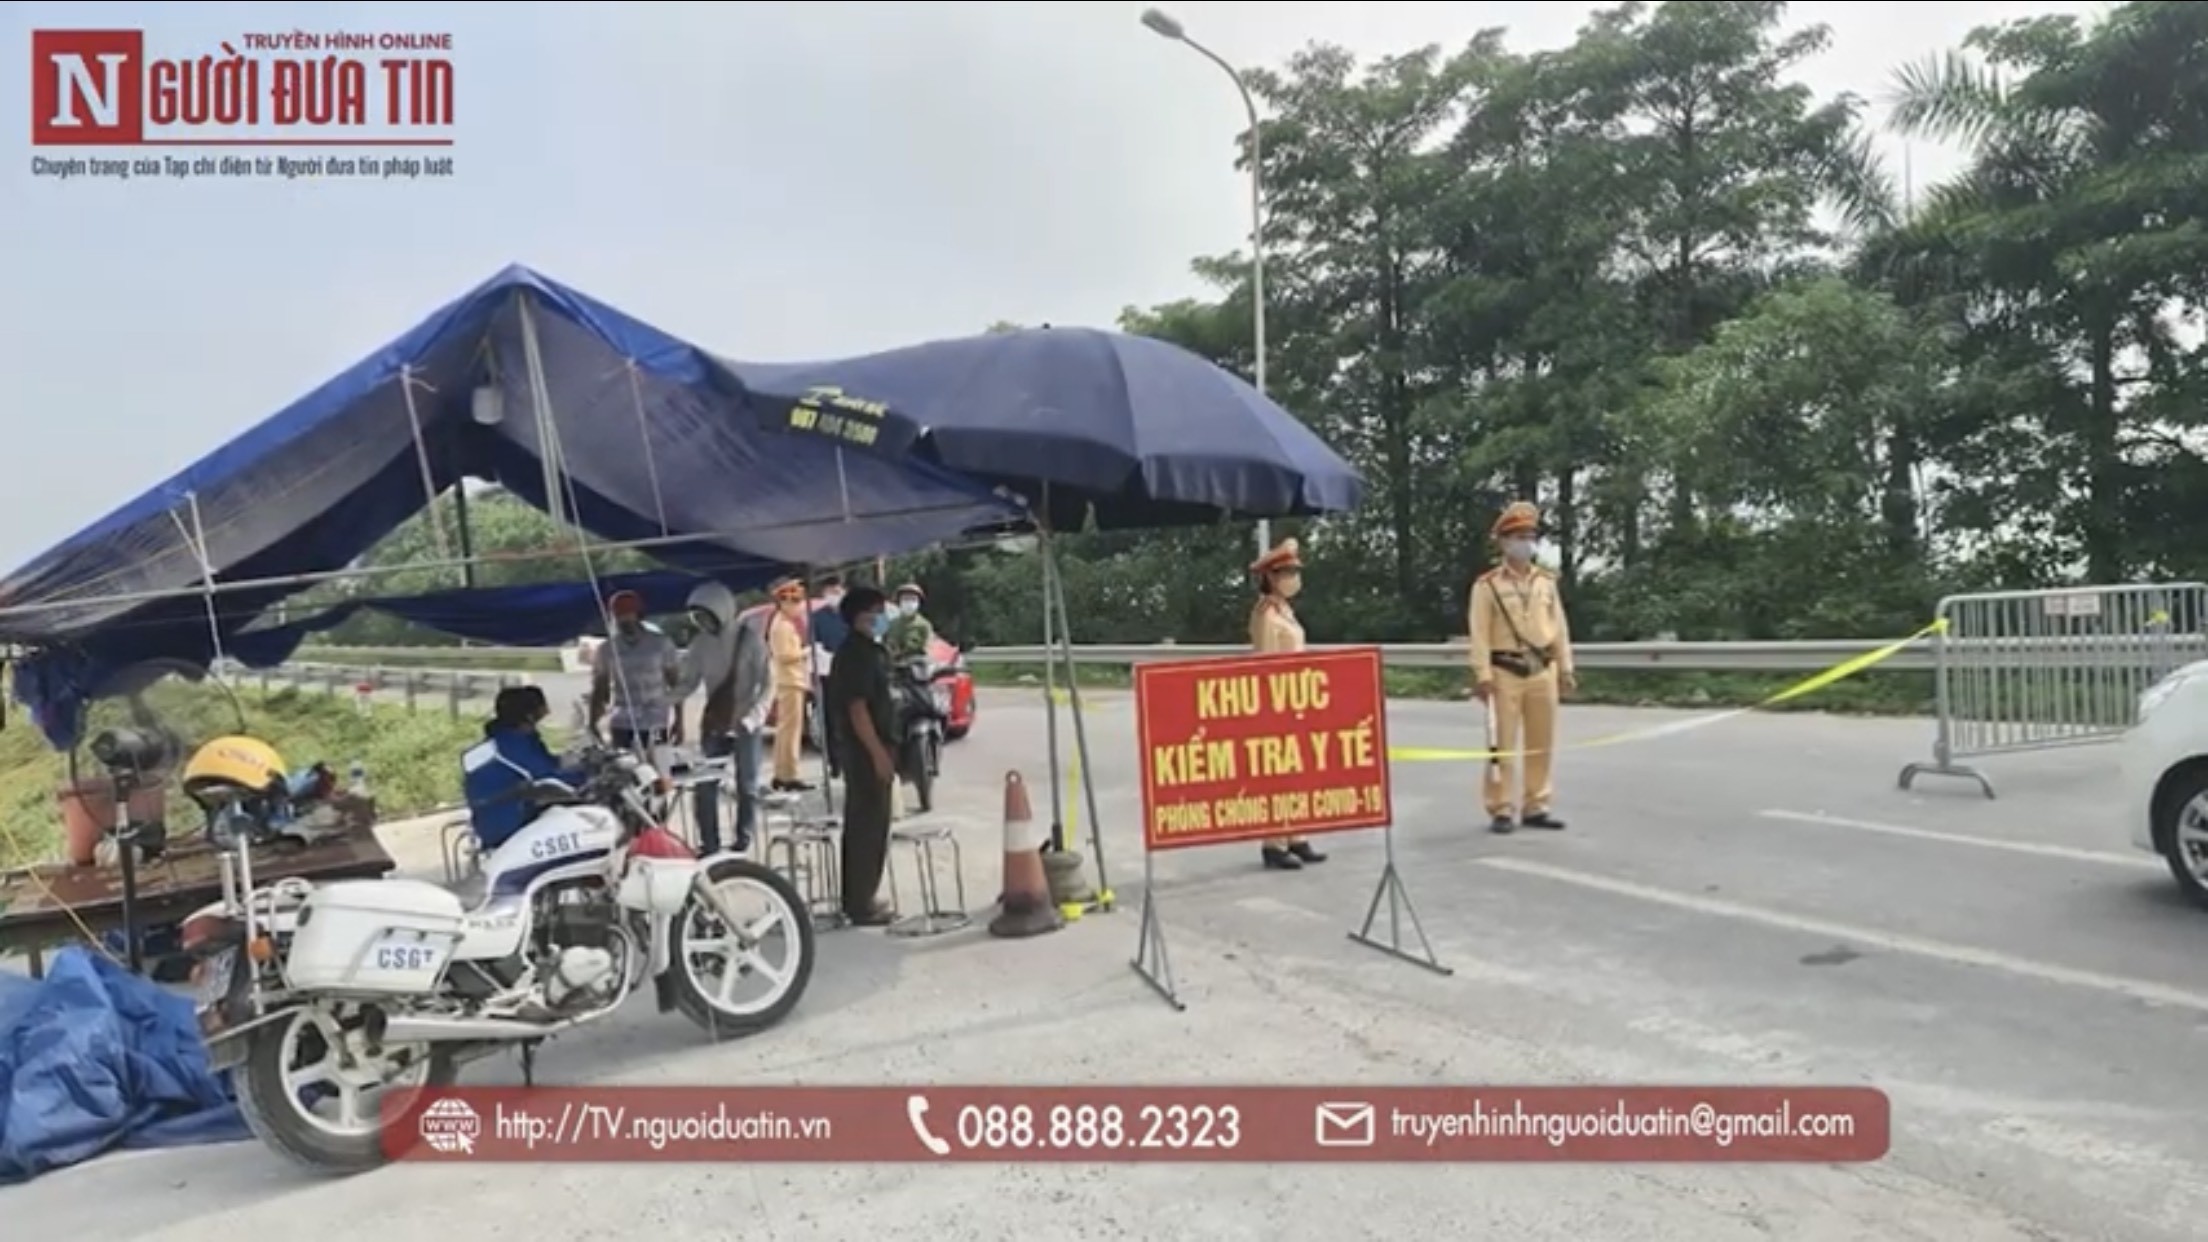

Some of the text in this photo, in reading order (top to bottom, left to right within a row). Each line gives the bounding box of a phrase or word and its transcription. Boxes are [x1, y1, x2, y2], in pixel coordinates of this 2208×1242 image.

[1197, 667, 1330, 720] KHU VỰC
[1154, 714, 1375, 786] KIỂM TRA Y TẾ
[1312, 784, 1382, 818] COVID-19
[531, 832, 580, 859] CSGT
[377, 947, 434, 969] CSGT
